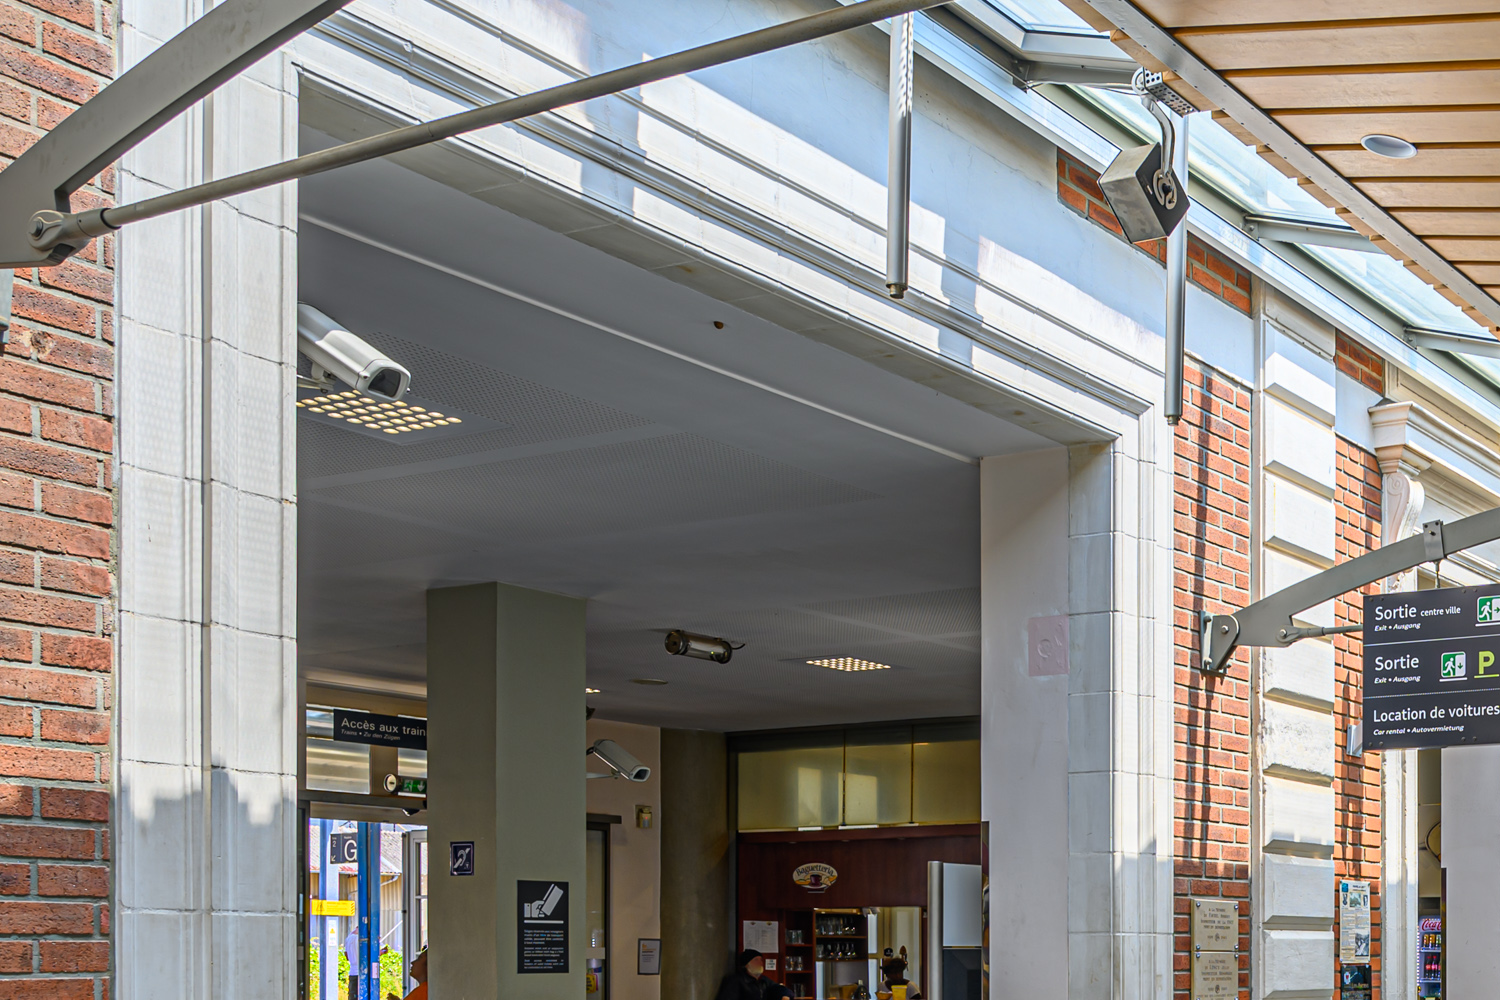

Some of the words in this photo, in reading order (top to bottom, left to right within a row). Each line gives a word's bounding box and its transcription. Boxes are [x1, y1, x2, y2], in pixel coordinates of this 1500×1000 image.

[1374, 603, 1417, 621] Sortie
[1420, 608, 1444, 617] centre
[1445, 605, 1461, 615] ville
[1374, 624, 1387, 632] Exit
[1392, 622, 1421, 631] Ausgang
[1374, 654, 1420, 671] Sortie
[1374, 676, 1387, 684] Exit
[1392, 675, 1421, 684] Ausgang
[1373, 707, 1427, 723] Location
[1429, 705, 1446, 719] de
[1448, 703, 1500, 718] voitures
[341, 718, 376, 731] Accès
[379, 724, 399, 734] aux
[402, 726, 426, 737] train
[1386, 727, 1406, 735] rental
[1412, 725, 1465, 735] Autovermietung
[344, 839, 357, 861] G
